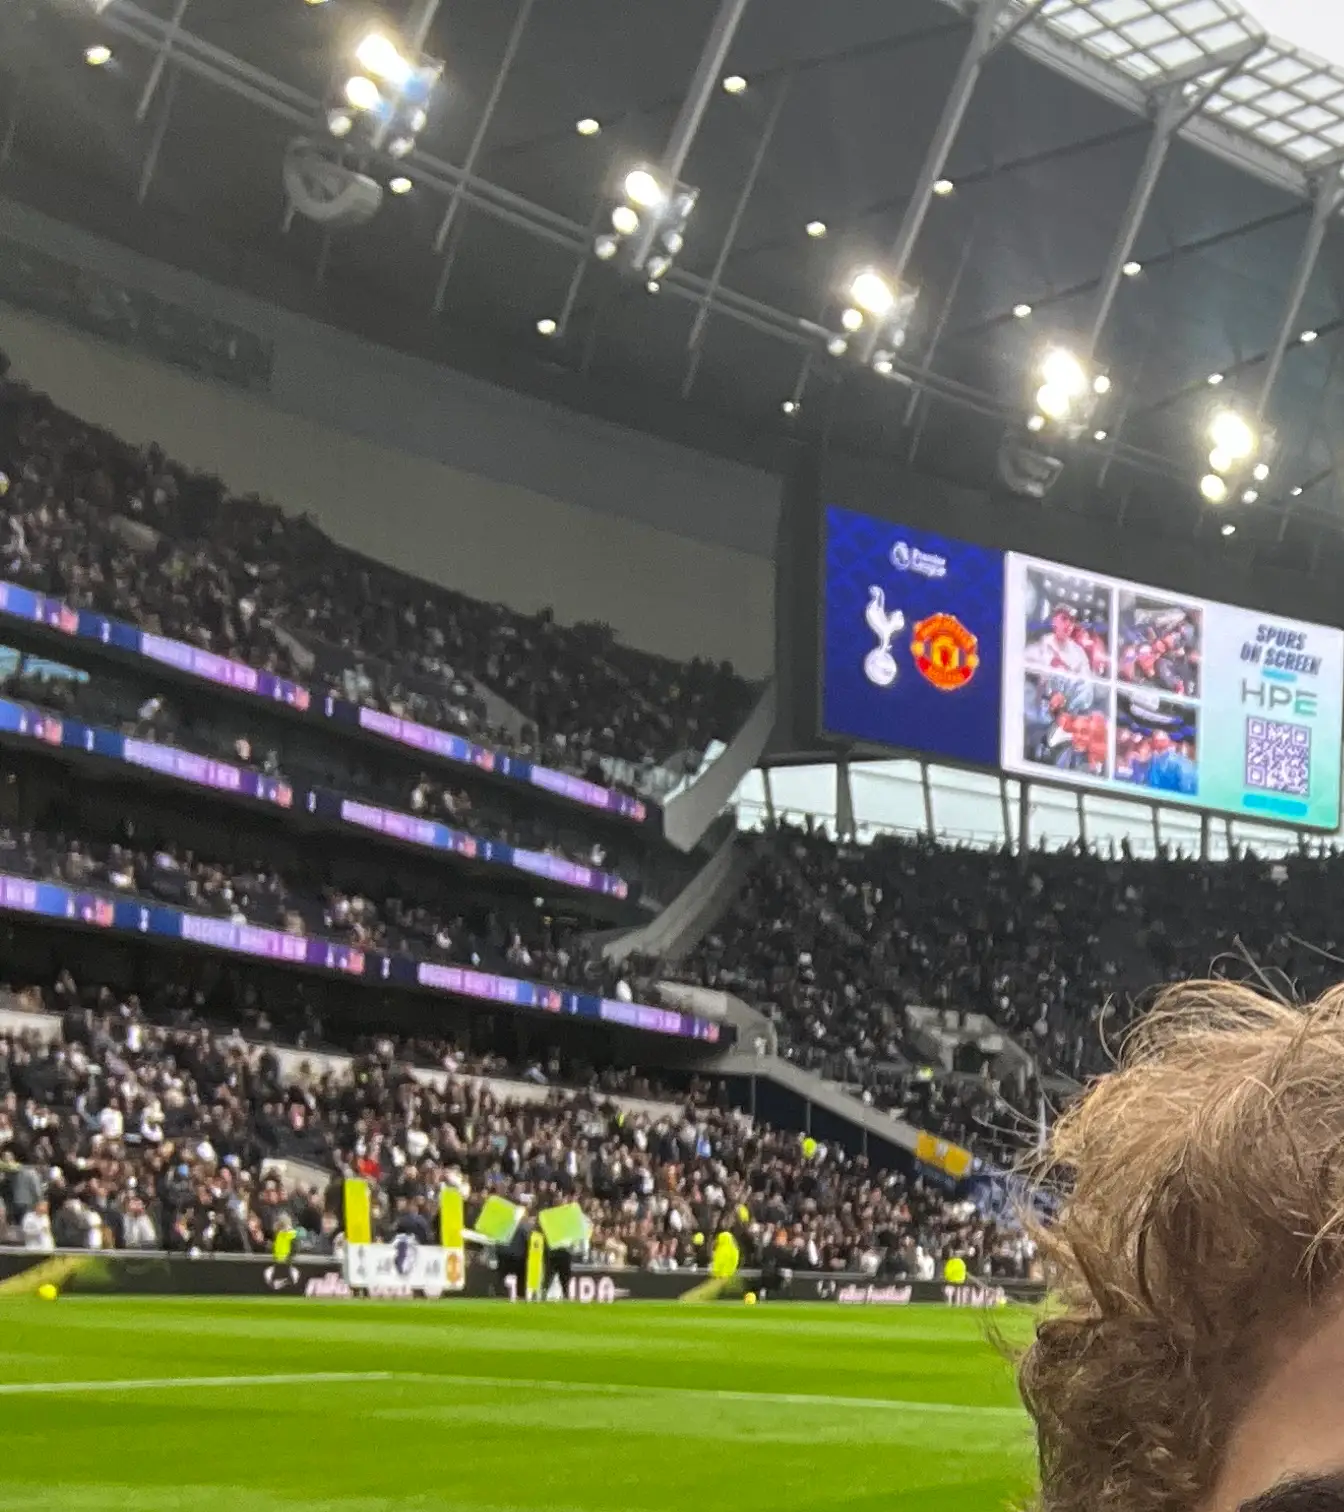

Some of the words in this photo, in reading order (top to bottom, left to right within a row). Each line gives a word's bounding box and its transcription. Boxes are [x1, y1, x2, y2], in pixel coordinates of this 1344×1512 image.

[1256, 624, 1308, 651] SPURS
[1240, 641, 1262, 664] ON
[1263, 647, 1322, 676] SCREEN
[1240, 678, 1318, 716] HPE
